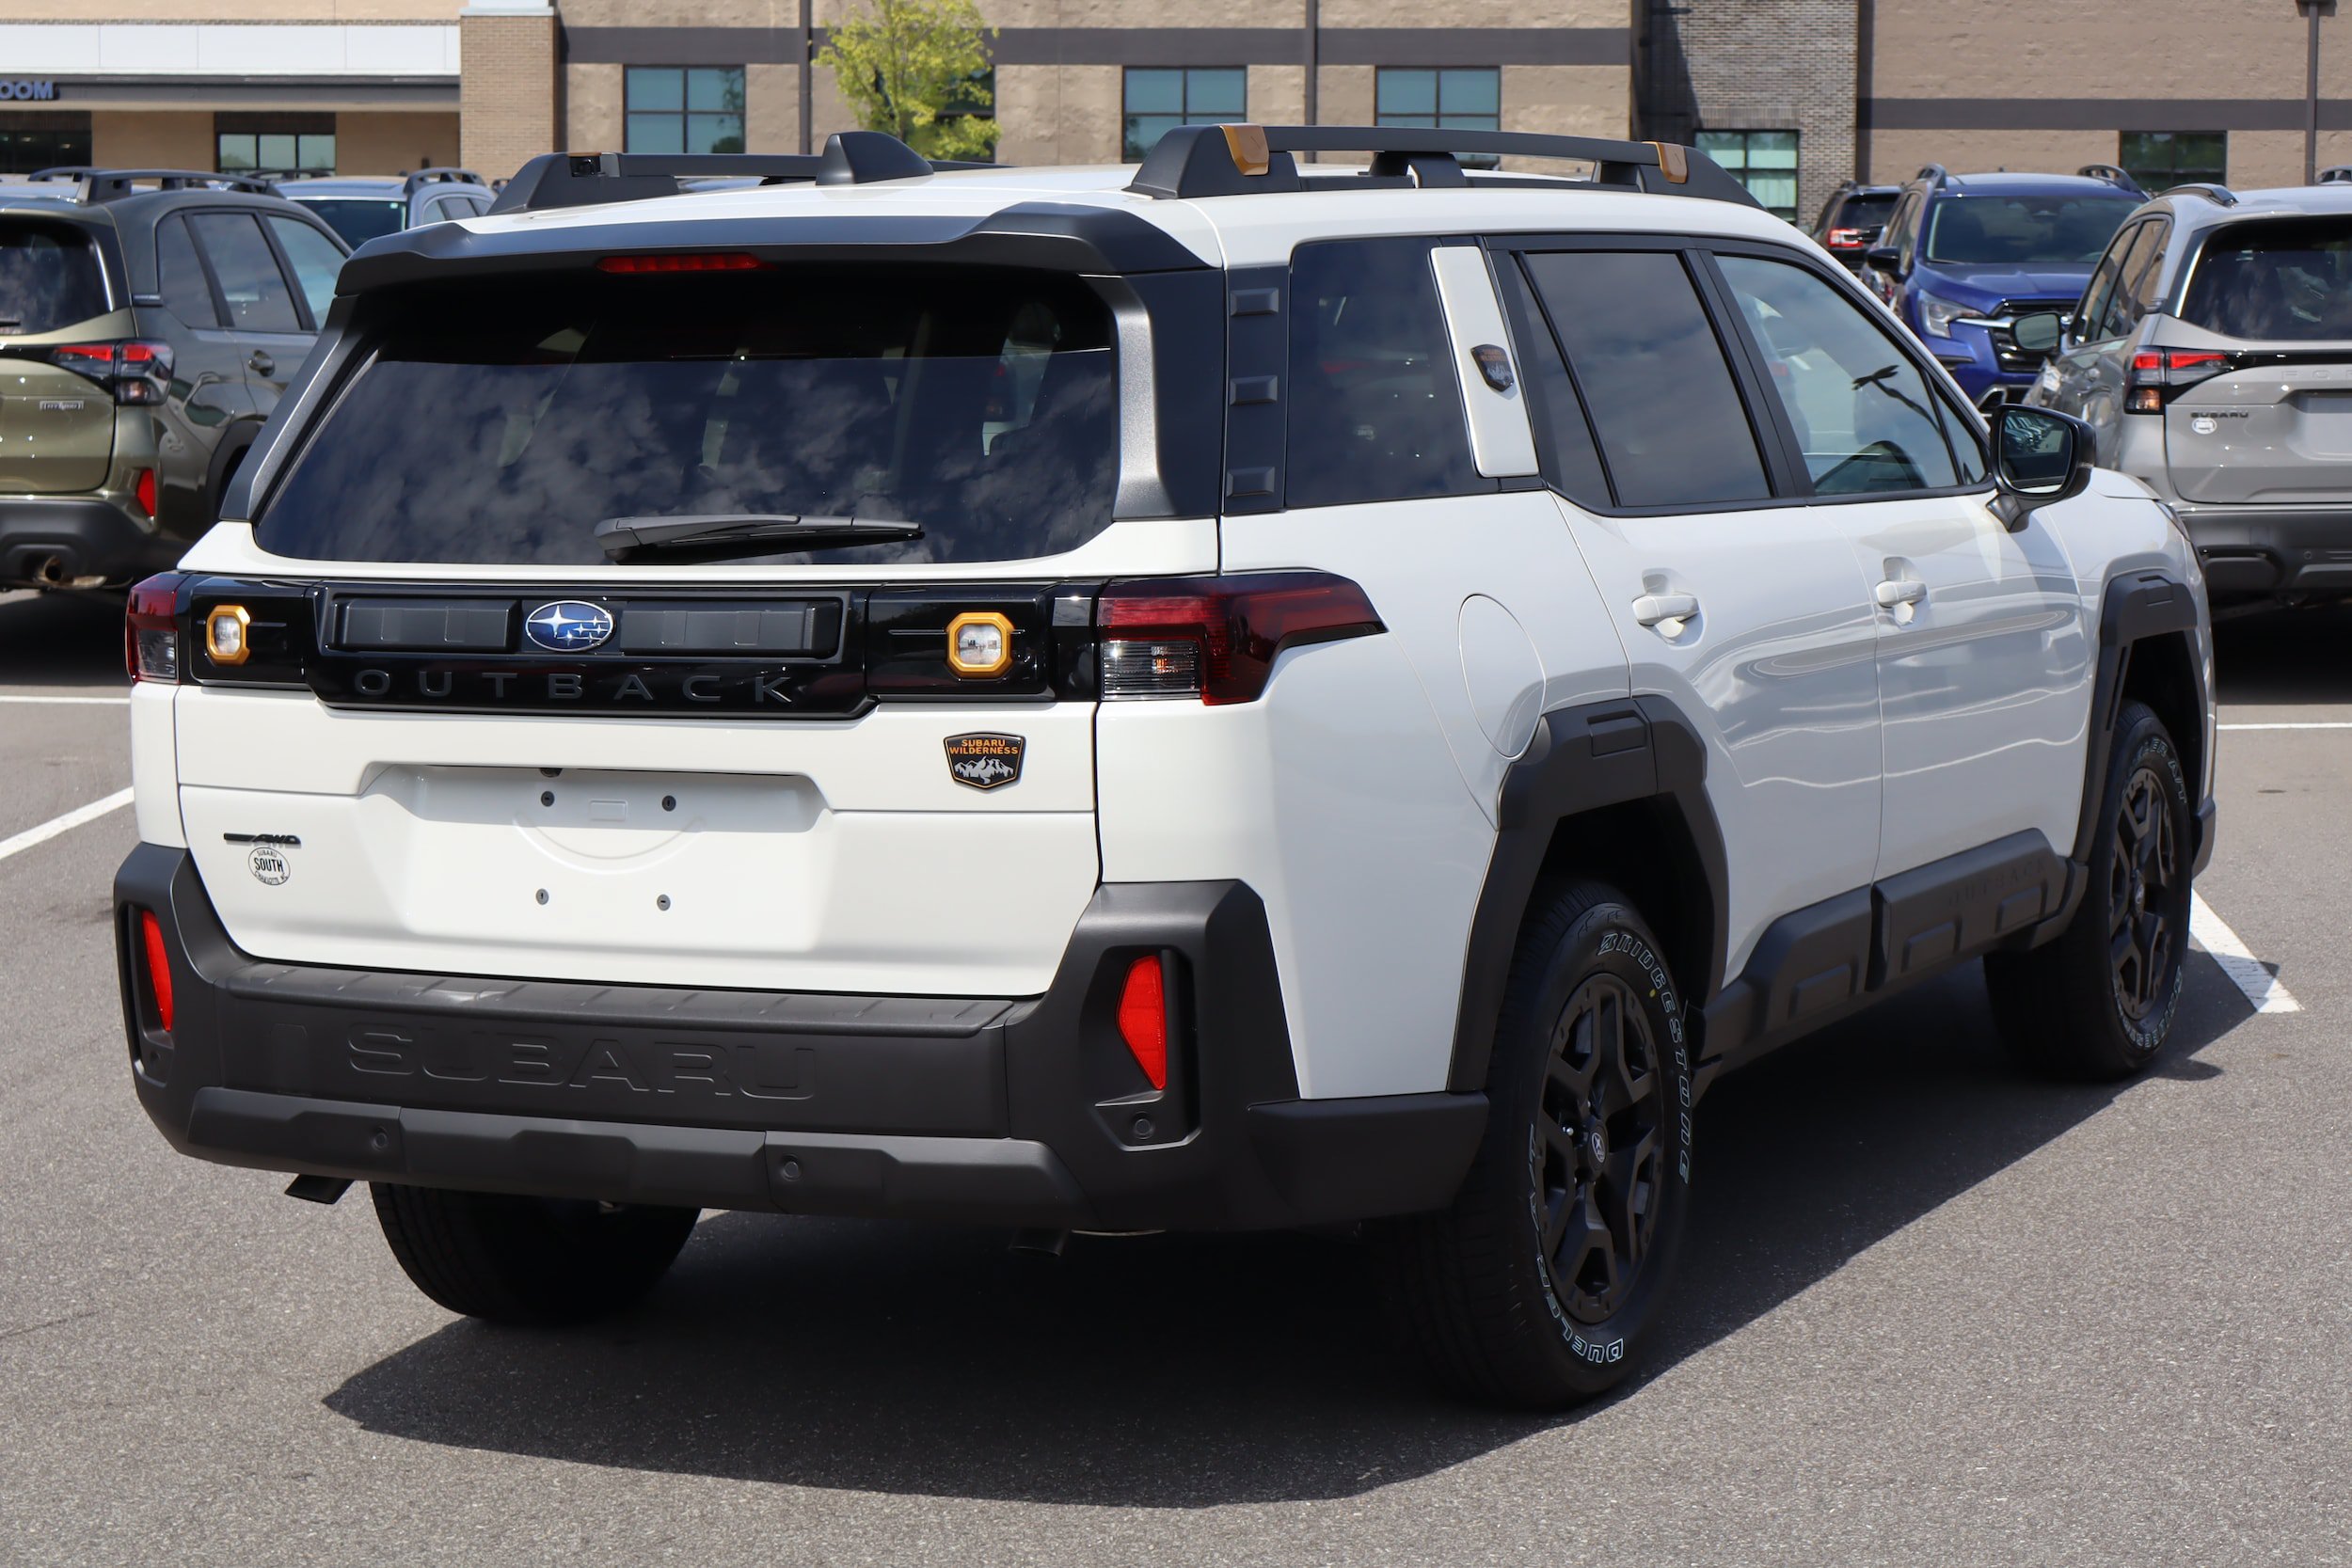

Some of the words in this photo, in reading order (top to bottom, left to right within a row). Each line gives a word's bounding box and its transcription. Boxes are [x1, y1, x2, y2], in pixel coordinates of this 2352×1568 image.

[354, 668, 793, 704] OUTBACK
[949, 746, 1019, 754] WILDERNESS
[961, 738, 1006, 747] SUBARU
[253, 857, 284, 873] SOUTH
[347, 1022, 816, 1100] SUBARU
[1597, 932, 1692, 1184] BRIDGESTONE
